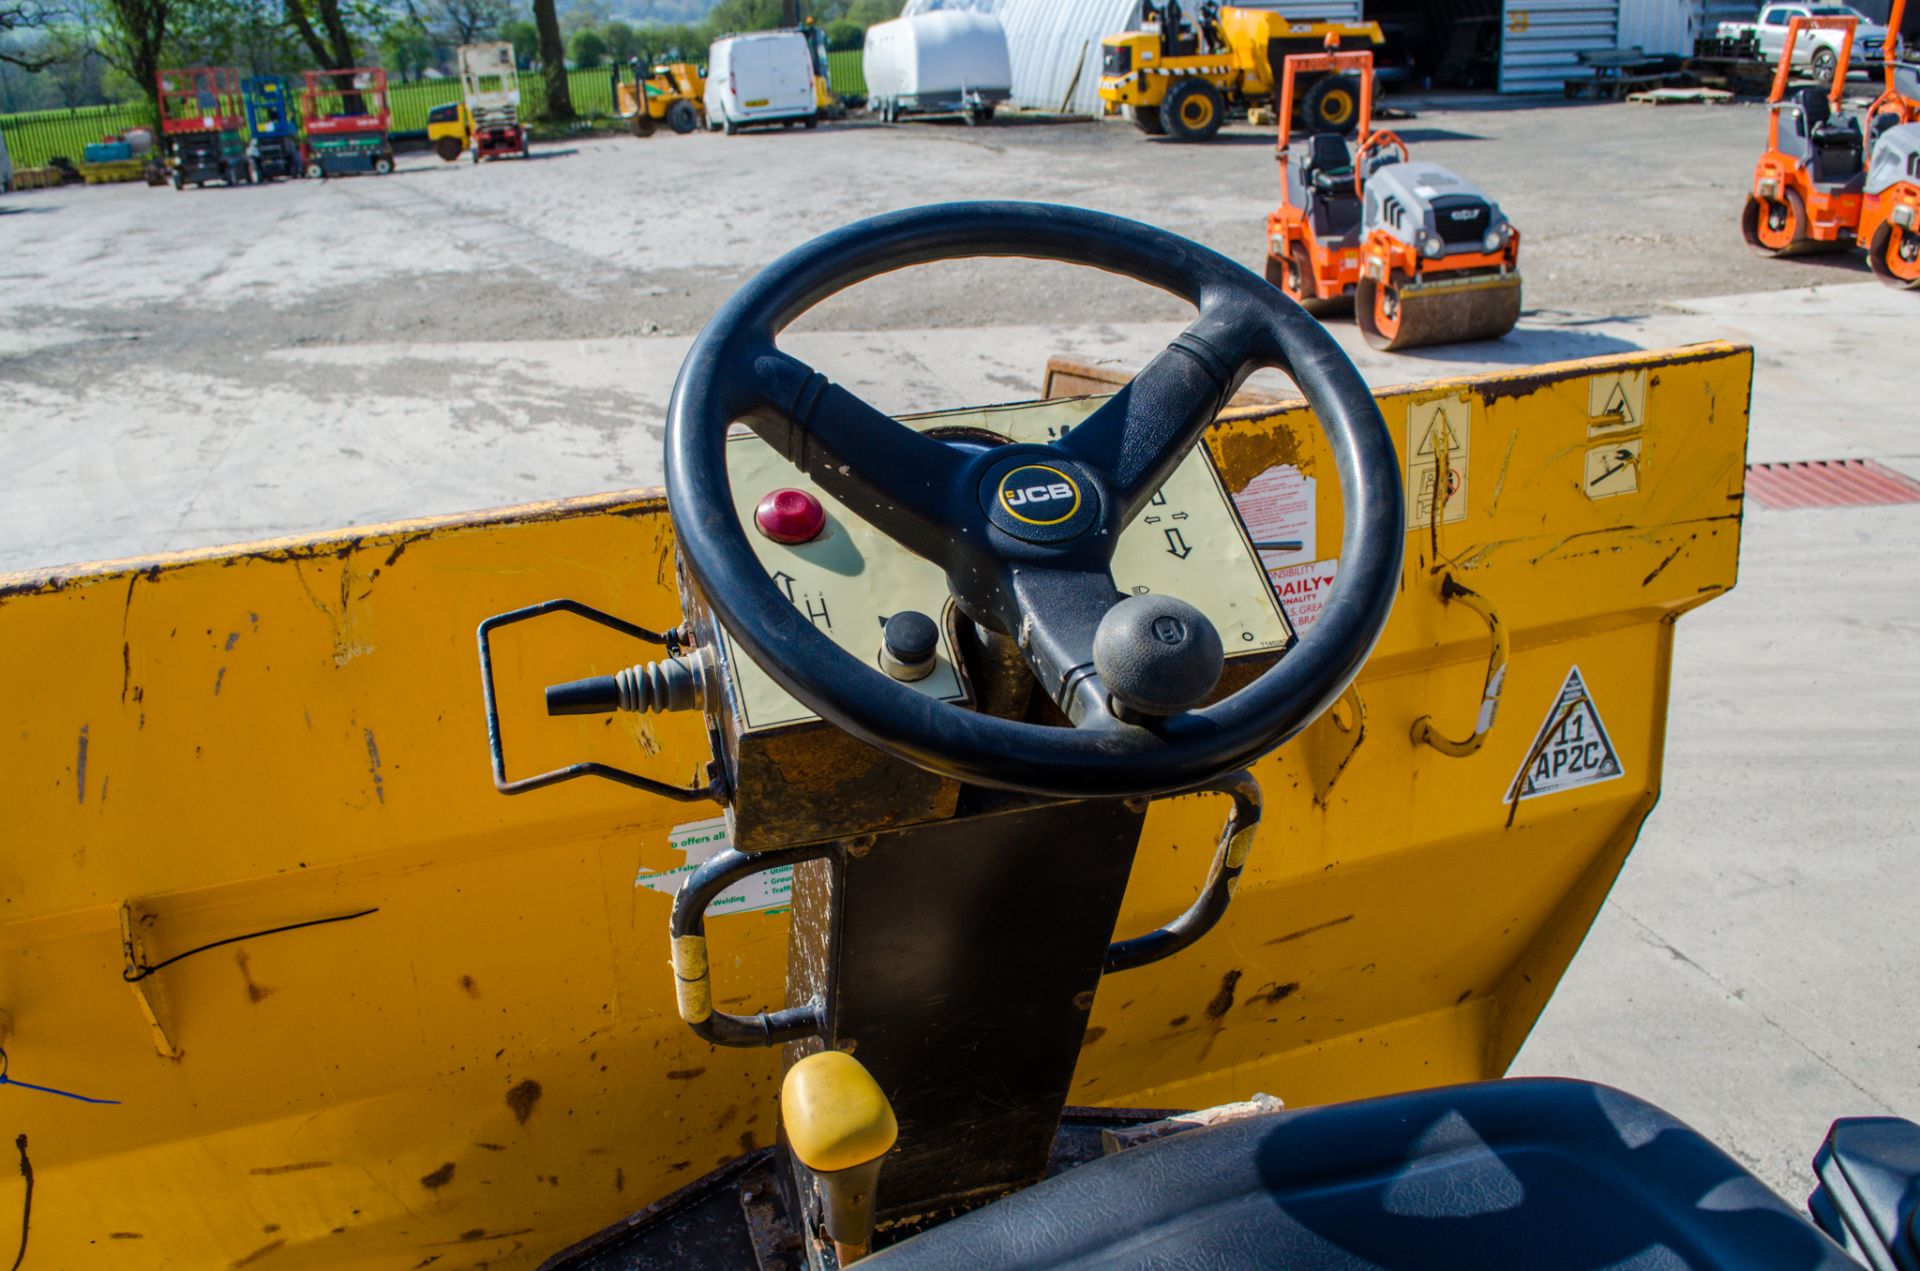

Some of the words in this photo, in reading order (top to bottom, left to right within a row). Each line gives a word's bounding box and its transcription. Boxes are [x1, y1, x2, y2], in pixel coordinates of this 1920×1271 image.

[1006, 482, 1074, 506] JCB
[1274, 576, 1322, 597] DAILY
[1299, 602, 1325, 615] GREA
[1554, 714, 1584, 747] 11
[1535, 741, 1599, 781] AP2C
[680, 834, 711, 847] offers
[713, 831, 725, 841] all
[713, 895, 746, 907] Welding
